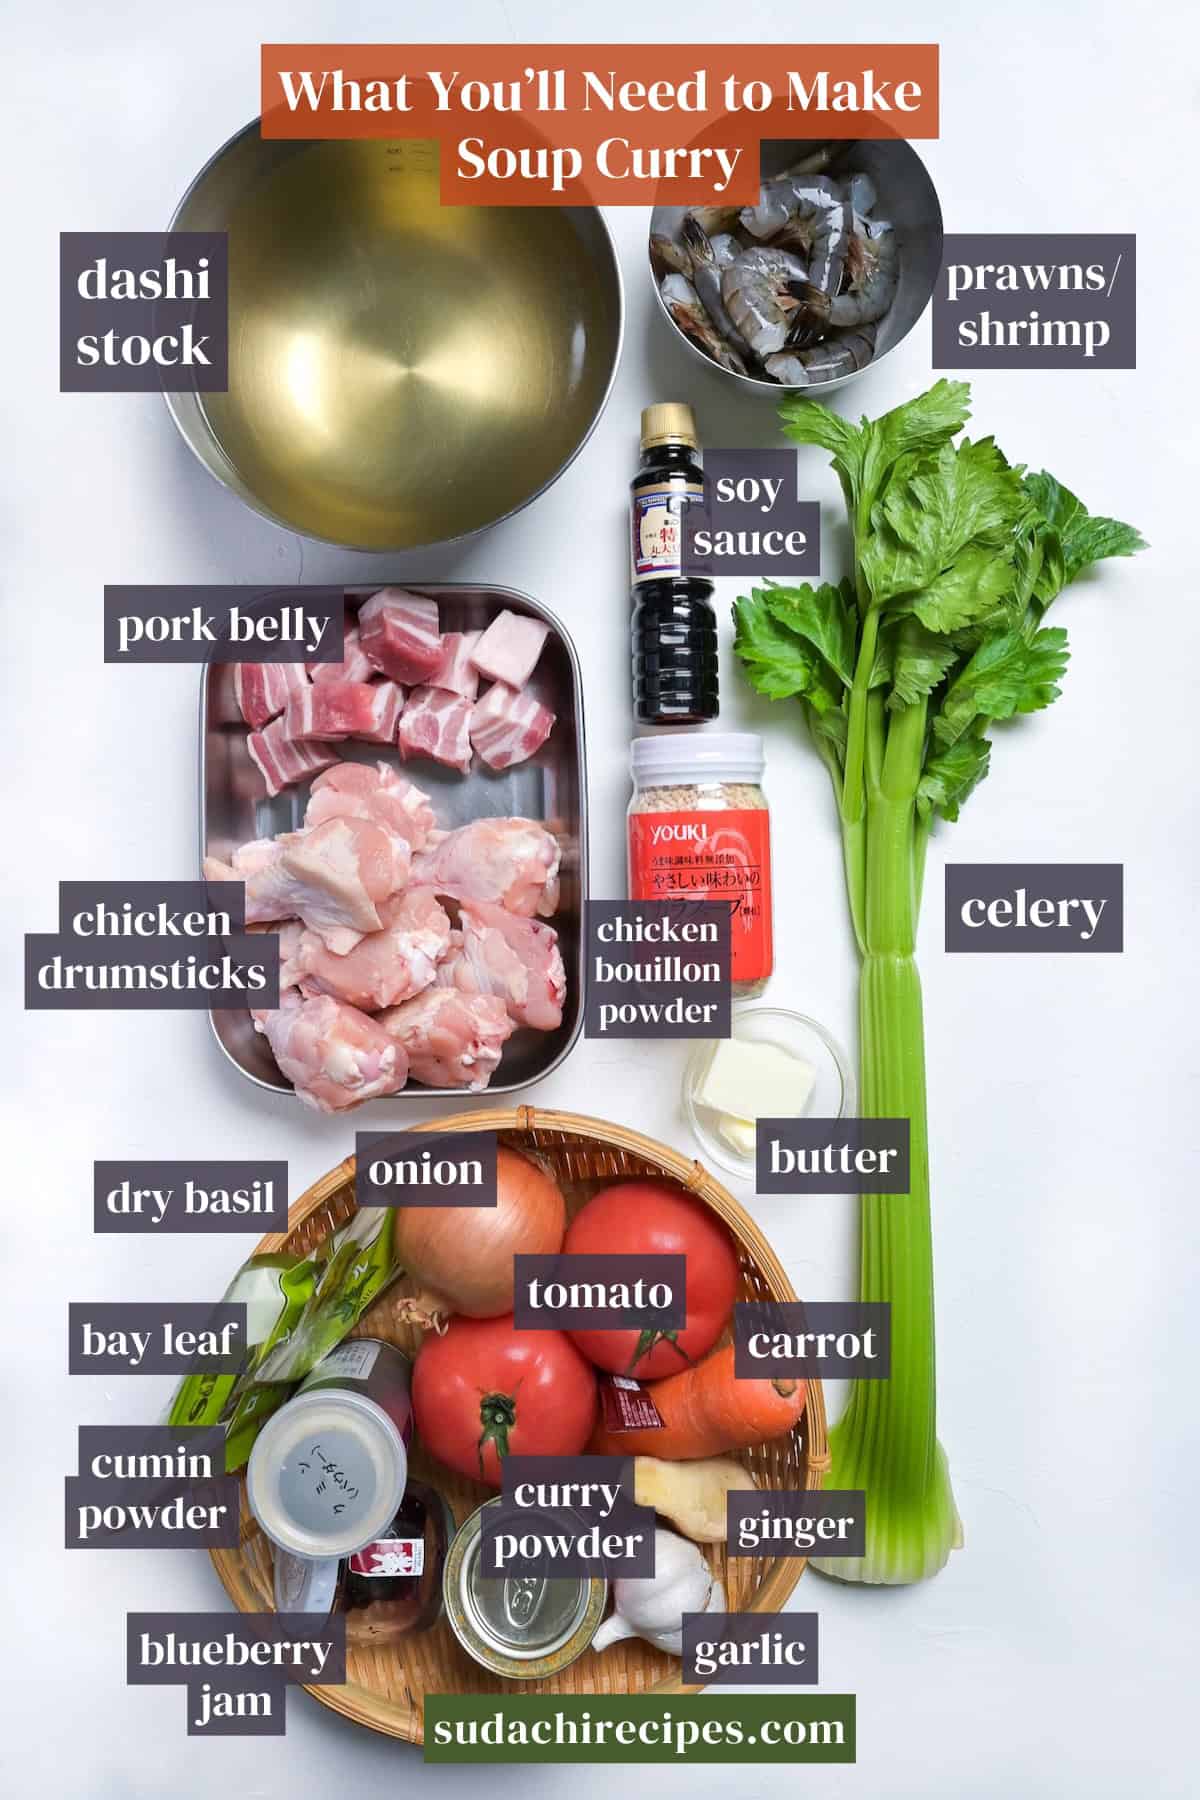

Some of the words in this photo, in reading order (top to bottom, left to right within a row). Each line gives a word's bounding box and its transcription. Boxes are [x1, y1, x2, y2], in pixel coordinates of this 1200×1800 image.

[654, 871, 760, 889] やさしい味わいの
